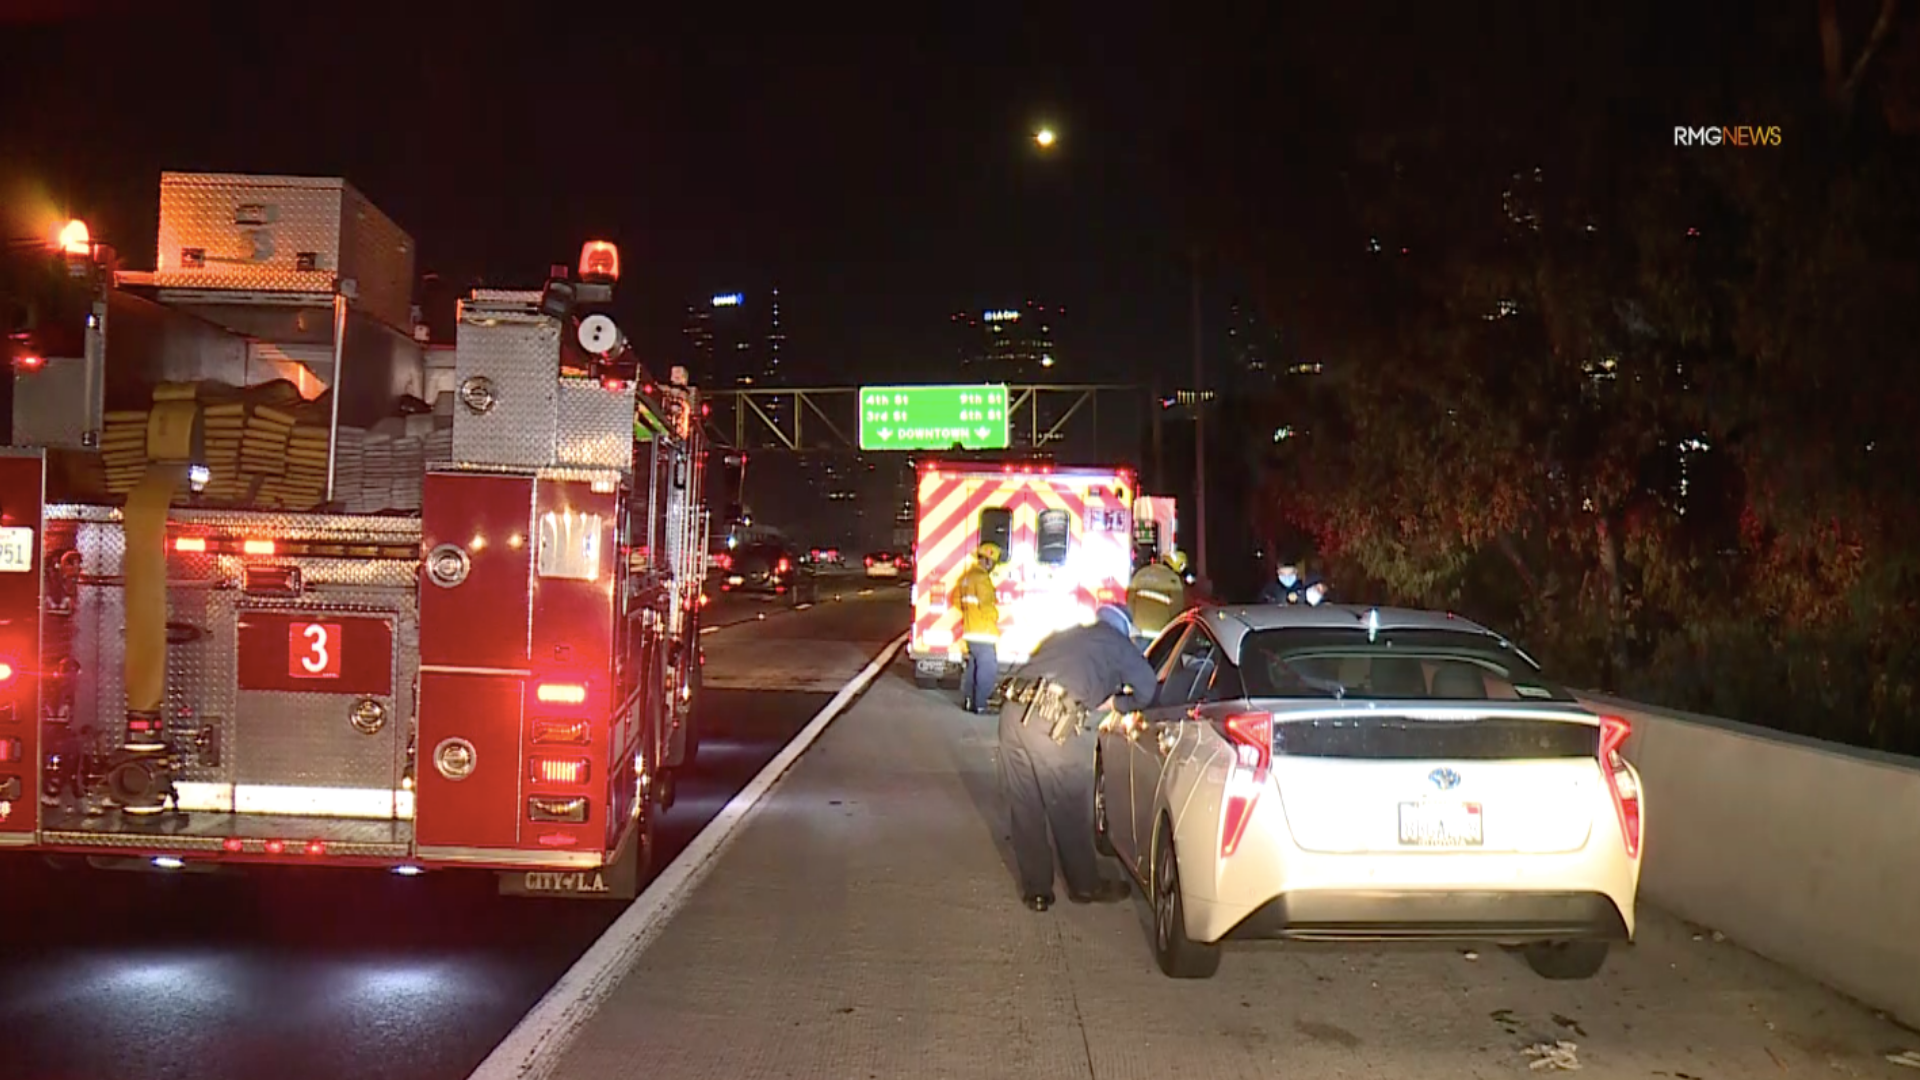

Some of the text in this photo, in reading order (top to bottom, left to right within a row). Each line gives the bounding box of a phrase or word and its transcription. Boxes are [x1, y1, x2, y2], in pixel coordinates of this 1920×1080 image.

[866, 394, 909, 406] 4th St
[959, 392, 1002, 405] 9th St
[866, 410, 908, 422] 3rd St
[988, 408, 1002, 421] St
[898, 427, 970, 440] DOWNTOWN
[302, 623, 328, 673] 3
[525, 872, 563, 890] CITY
[577, 872, 610, 891] L.A.
